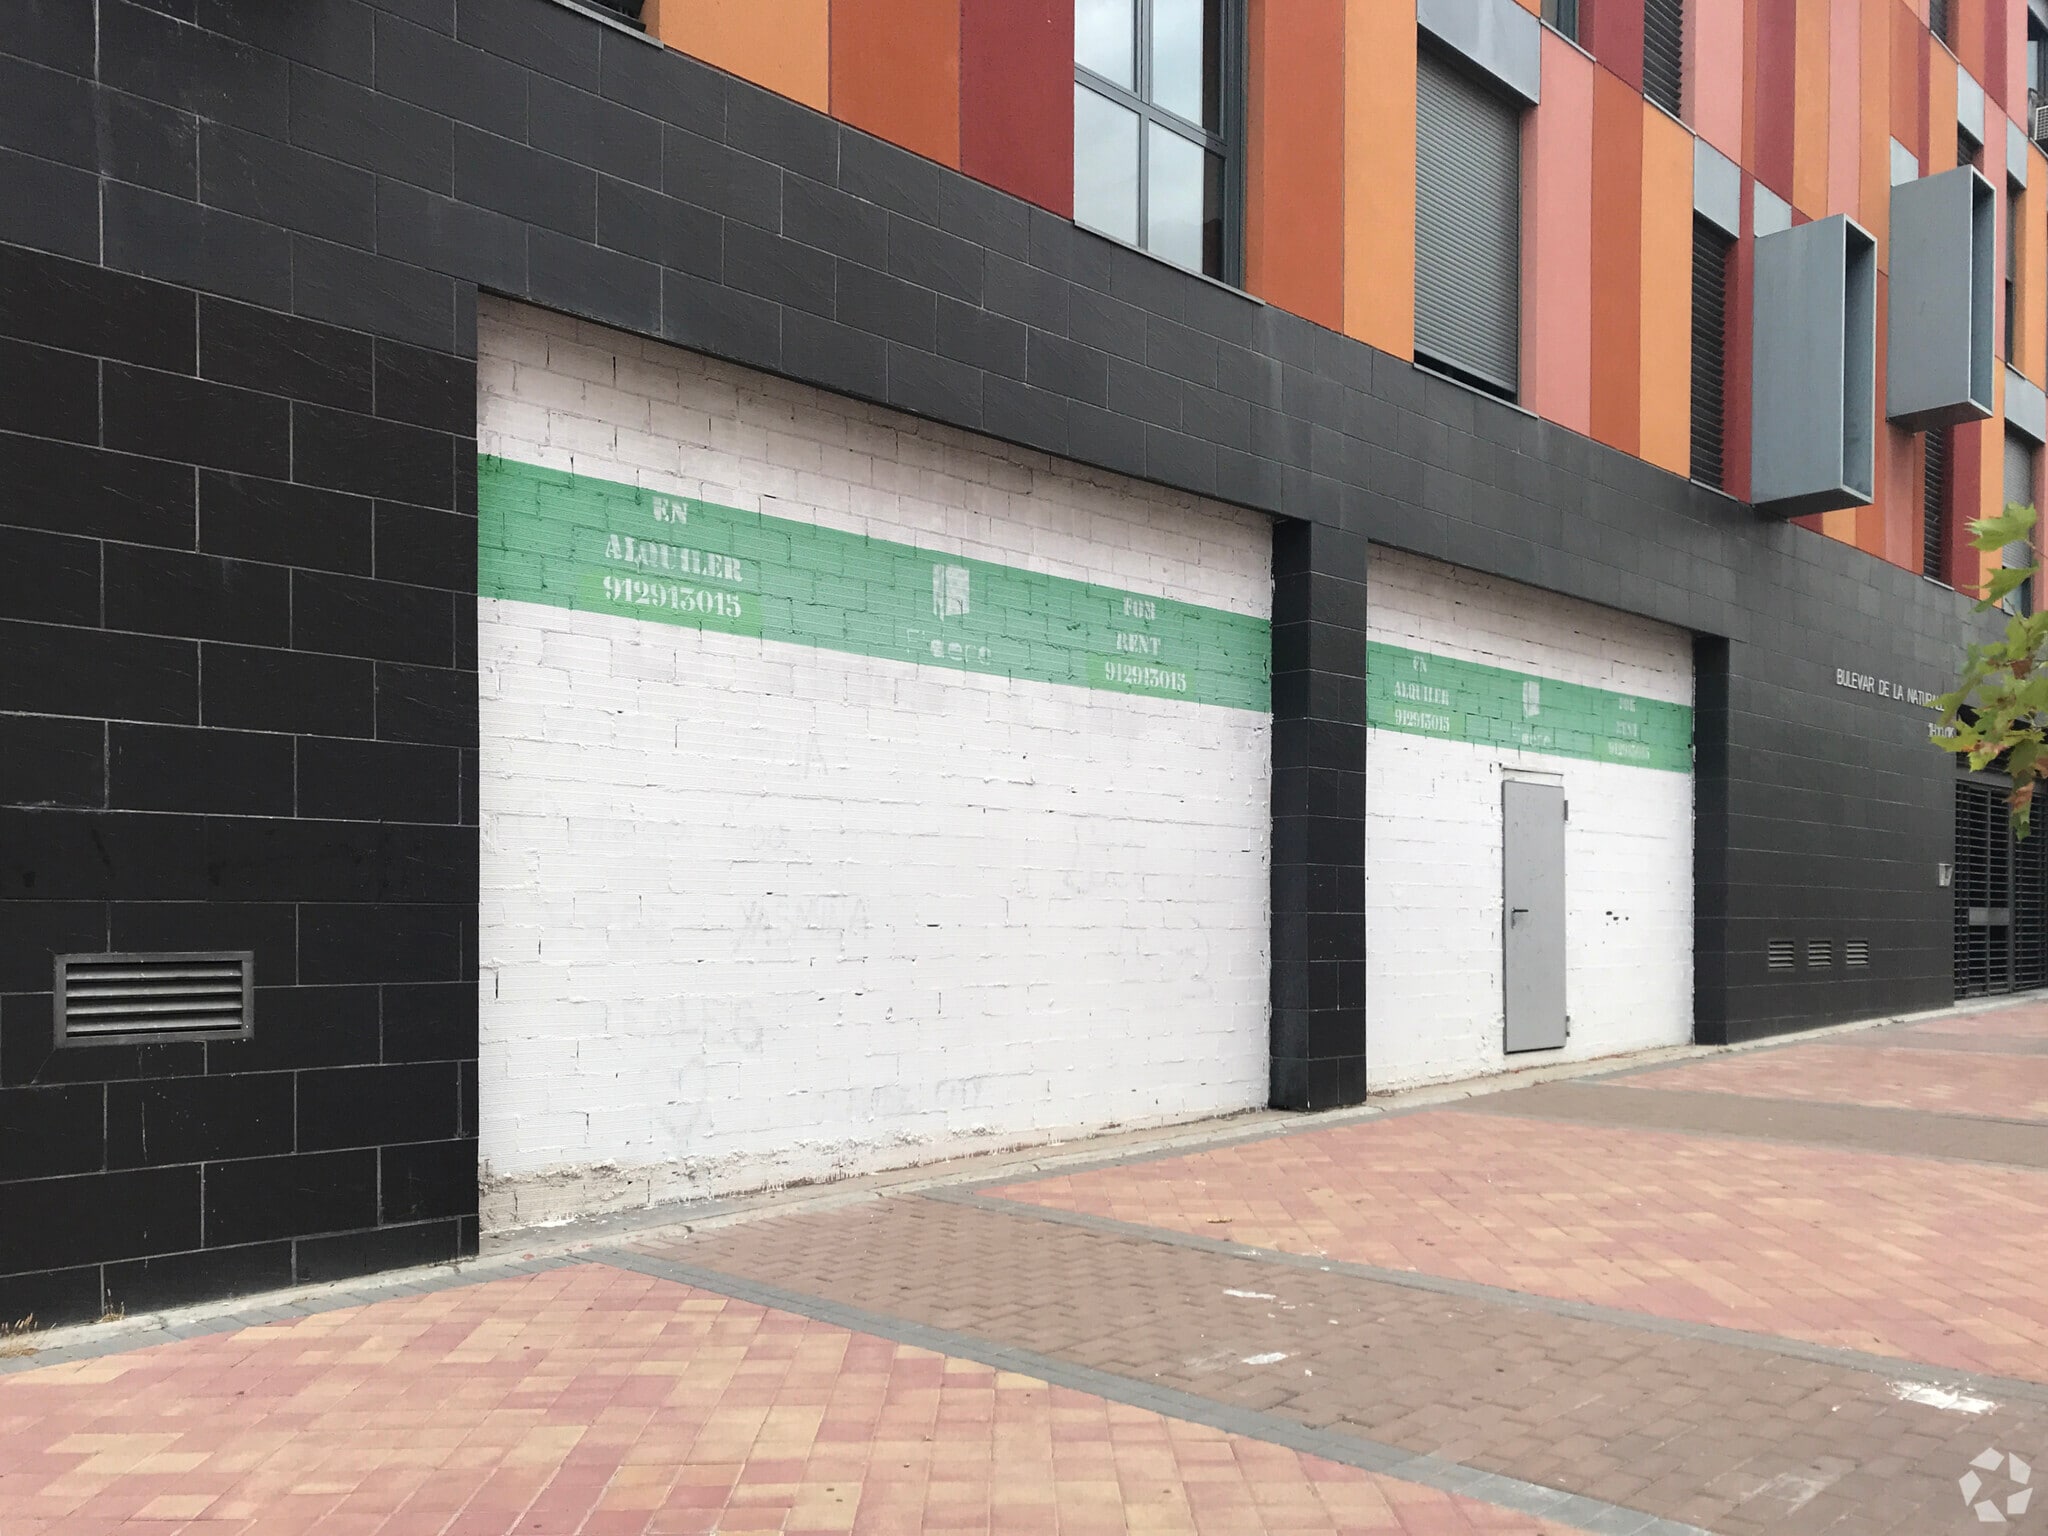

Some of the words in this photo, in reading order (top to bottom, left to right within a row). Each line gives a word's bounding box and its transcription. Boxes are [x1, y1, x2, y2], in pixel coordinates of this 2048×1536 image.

[653, 496, 688, 524] EN
[604, 533, 743, 582] ALQUILER
[602, 575, 742, 618] 912913015
[1116, 632, 1161, 656] RENT
[1104, 661, 1187, 691] 912913015
[1836, 668, 1875, 693] BULEVAR
[1878, 679, 1890, 698] DE
[1893, 683, 1904, 701] LA
